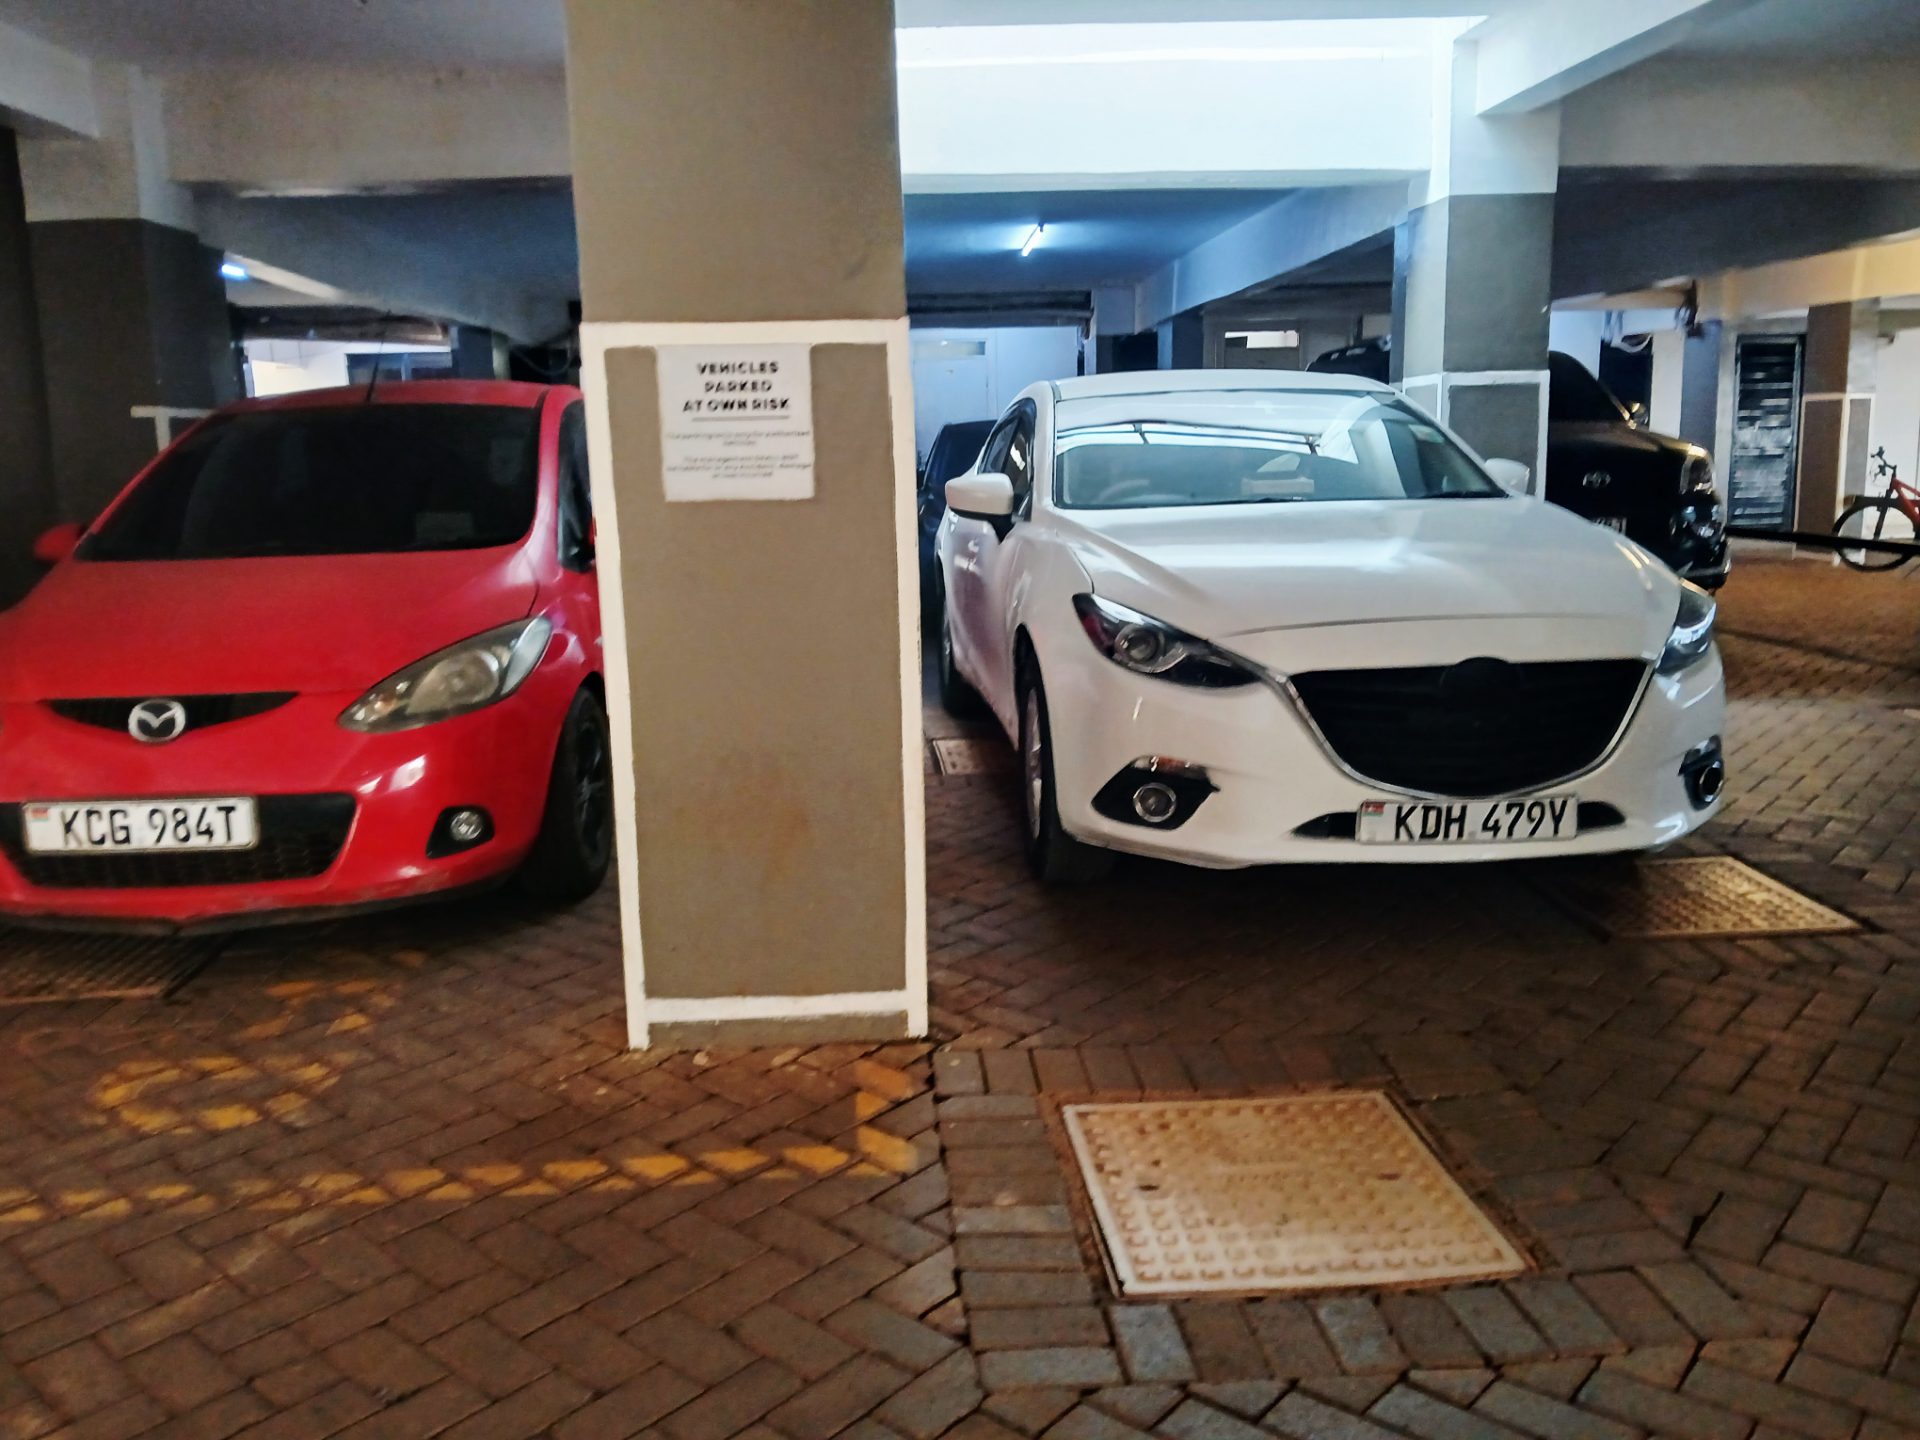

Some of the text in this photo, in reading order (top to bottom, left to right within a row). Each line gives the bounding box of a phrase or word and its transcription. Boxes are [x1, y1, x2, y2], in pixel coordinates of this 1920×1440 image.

[697, 361, 779, 374] VEHICLES
[704, 381, 772, 393] PARKED
[682, 398, 789, 412] AT OWN RISK
[60, 805, 236, 847] KCG 984T
[1394, 798, 1568, 842] KDH 479Y
